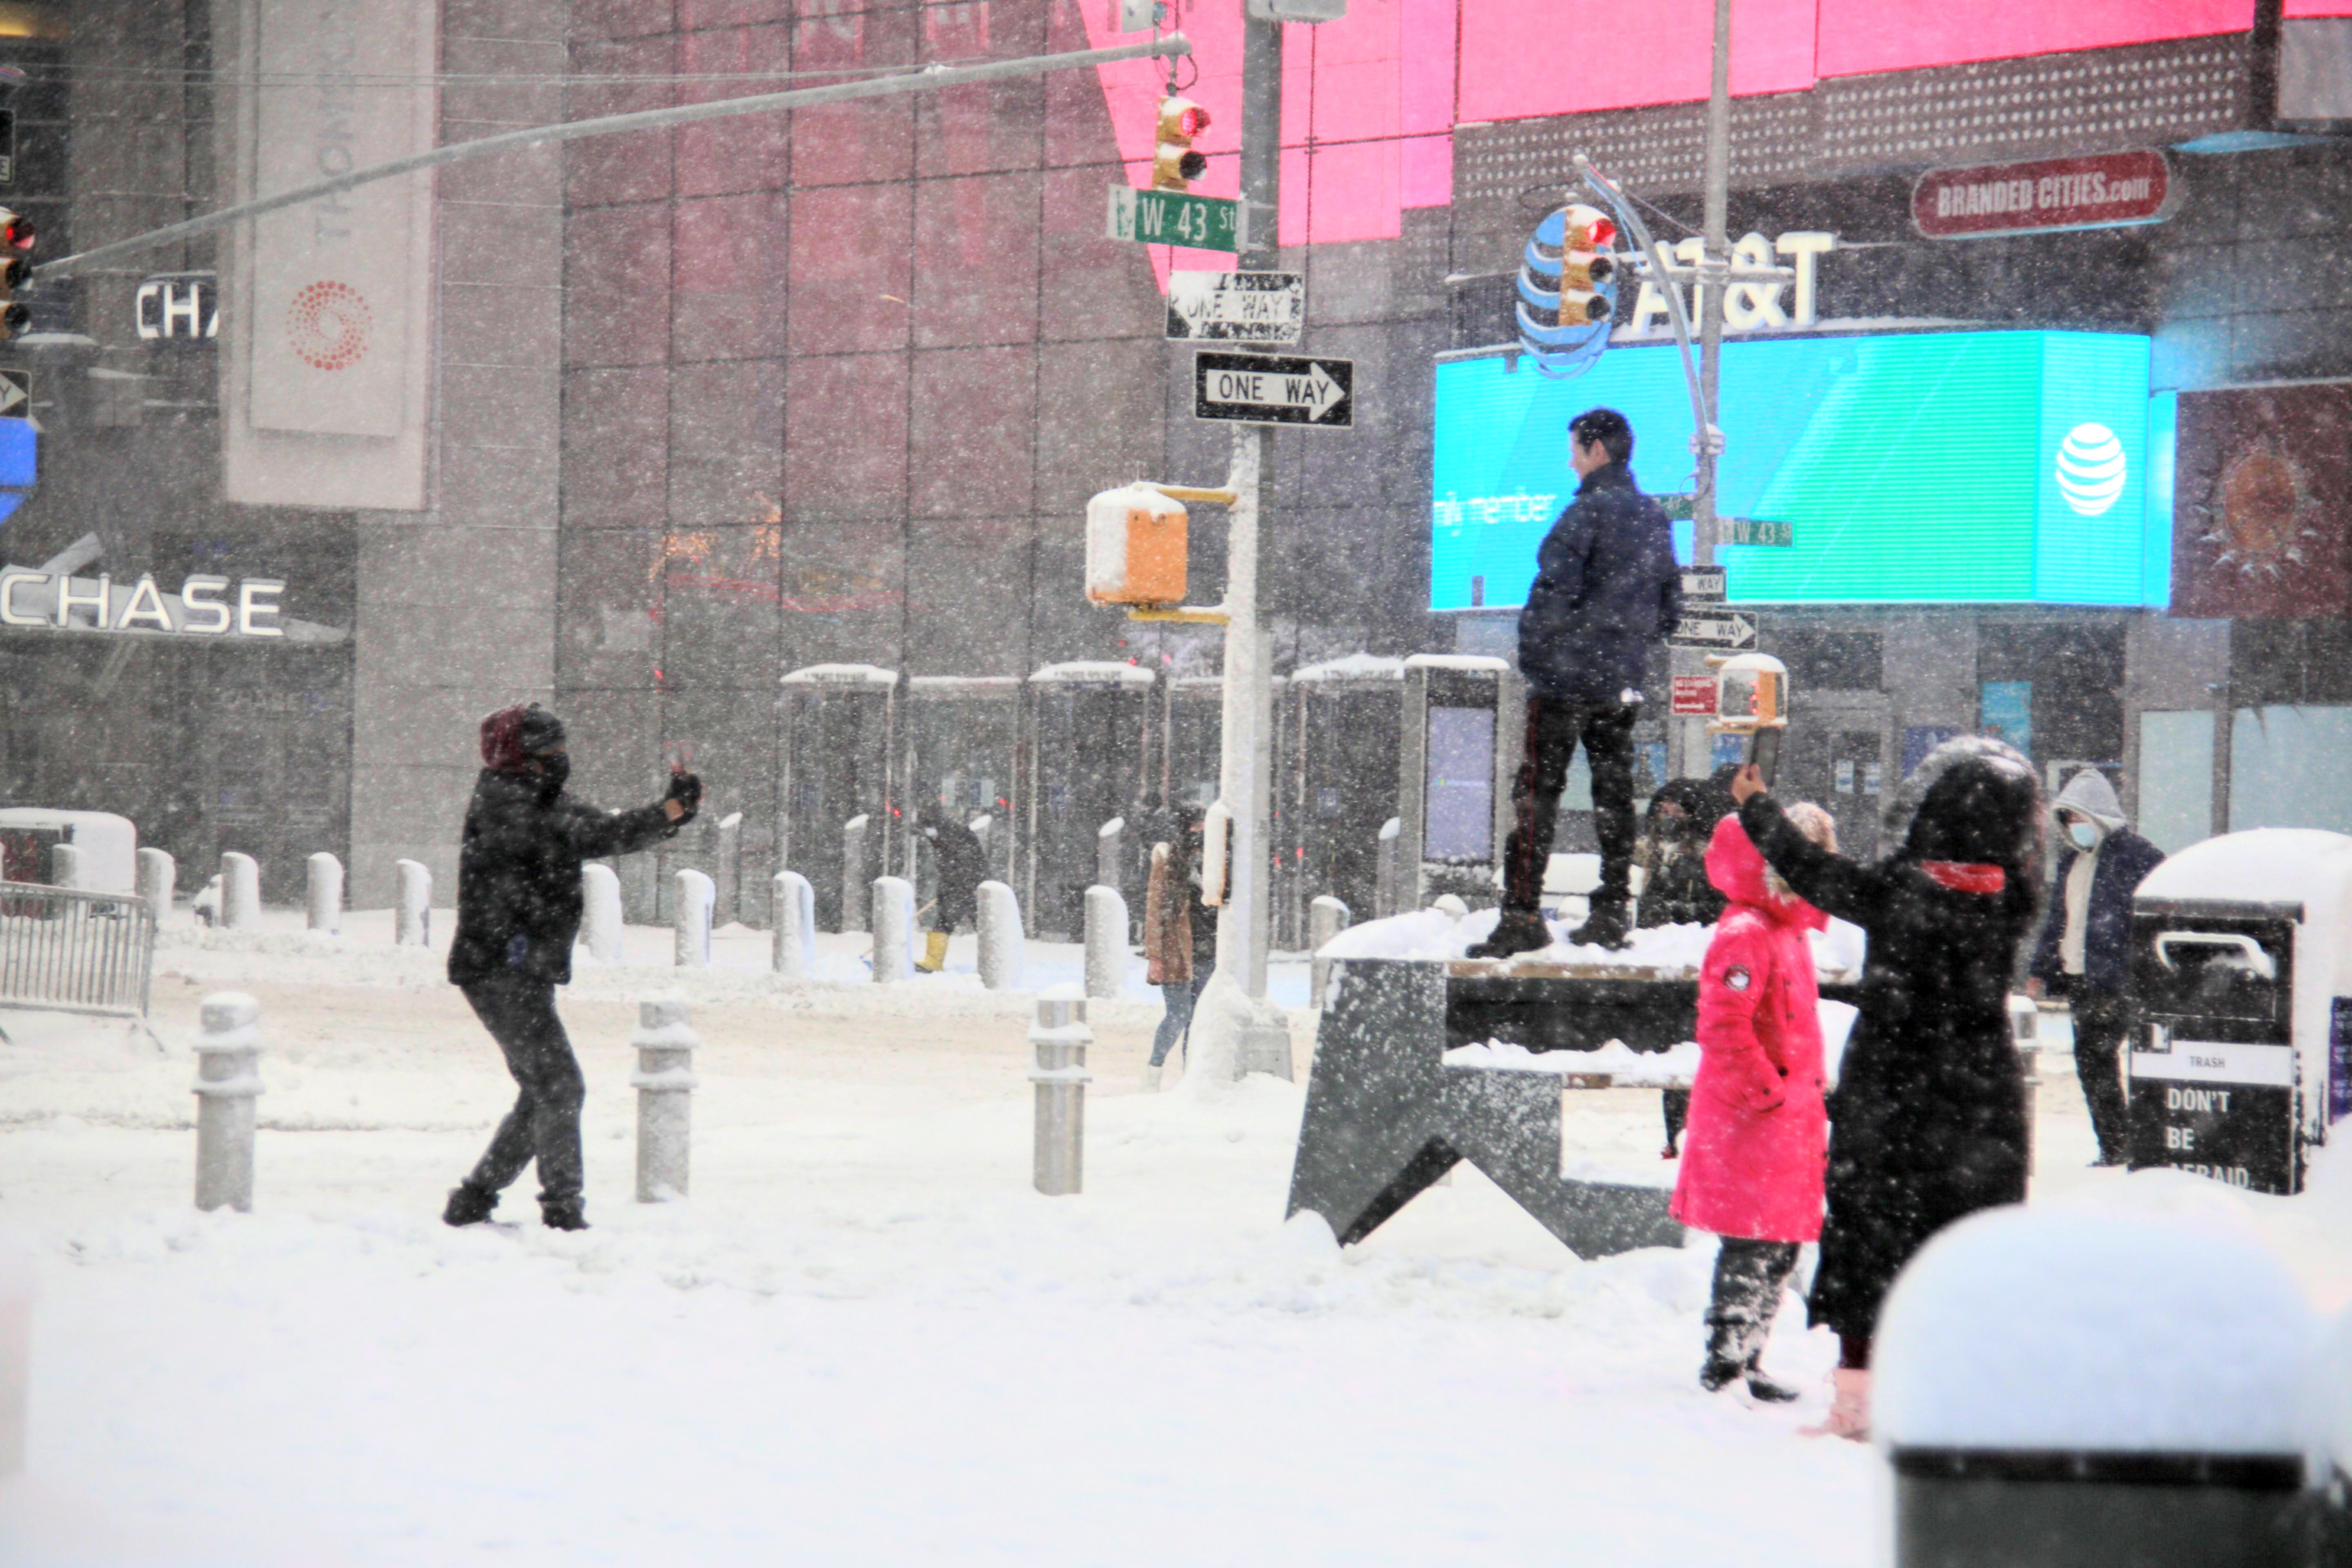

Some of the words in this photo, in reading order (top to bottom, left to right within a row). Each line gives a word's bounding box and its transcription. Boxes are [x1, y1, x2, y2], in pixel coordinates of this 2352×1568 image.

[1937, 179, 2034, 217] BRANDED
[2038, 170, 2151, 209] CITIES.com
[1143, 197, 1166, 236] W
[1178, 202, 1207, 241] 43
[1218, 205, 1235, 230] St
[1632, 232, 1837, 334] AT&T
[136, 281, 219, 339] CH
[1187, 293, 1223, 319] ONE
[1242, 293, 1283, 320] WAY
[1219, 374, 1264, 401] ONE
[1285, 377, 1331, 405] WAY
[1737, 521, 1751, 543] W
[1758, 522, 1775, 544] 43
[1697, 577, 1720, 590] WAY
[1, 572, 286, 636] CHASE
[1717, 623, 1744, 638] WAY
[2189, 1055, 2226, 1069] TRASH
[2166, 1087, 2231, 1113] DON'T
[2165, 1126, 2195, 1150] BE
